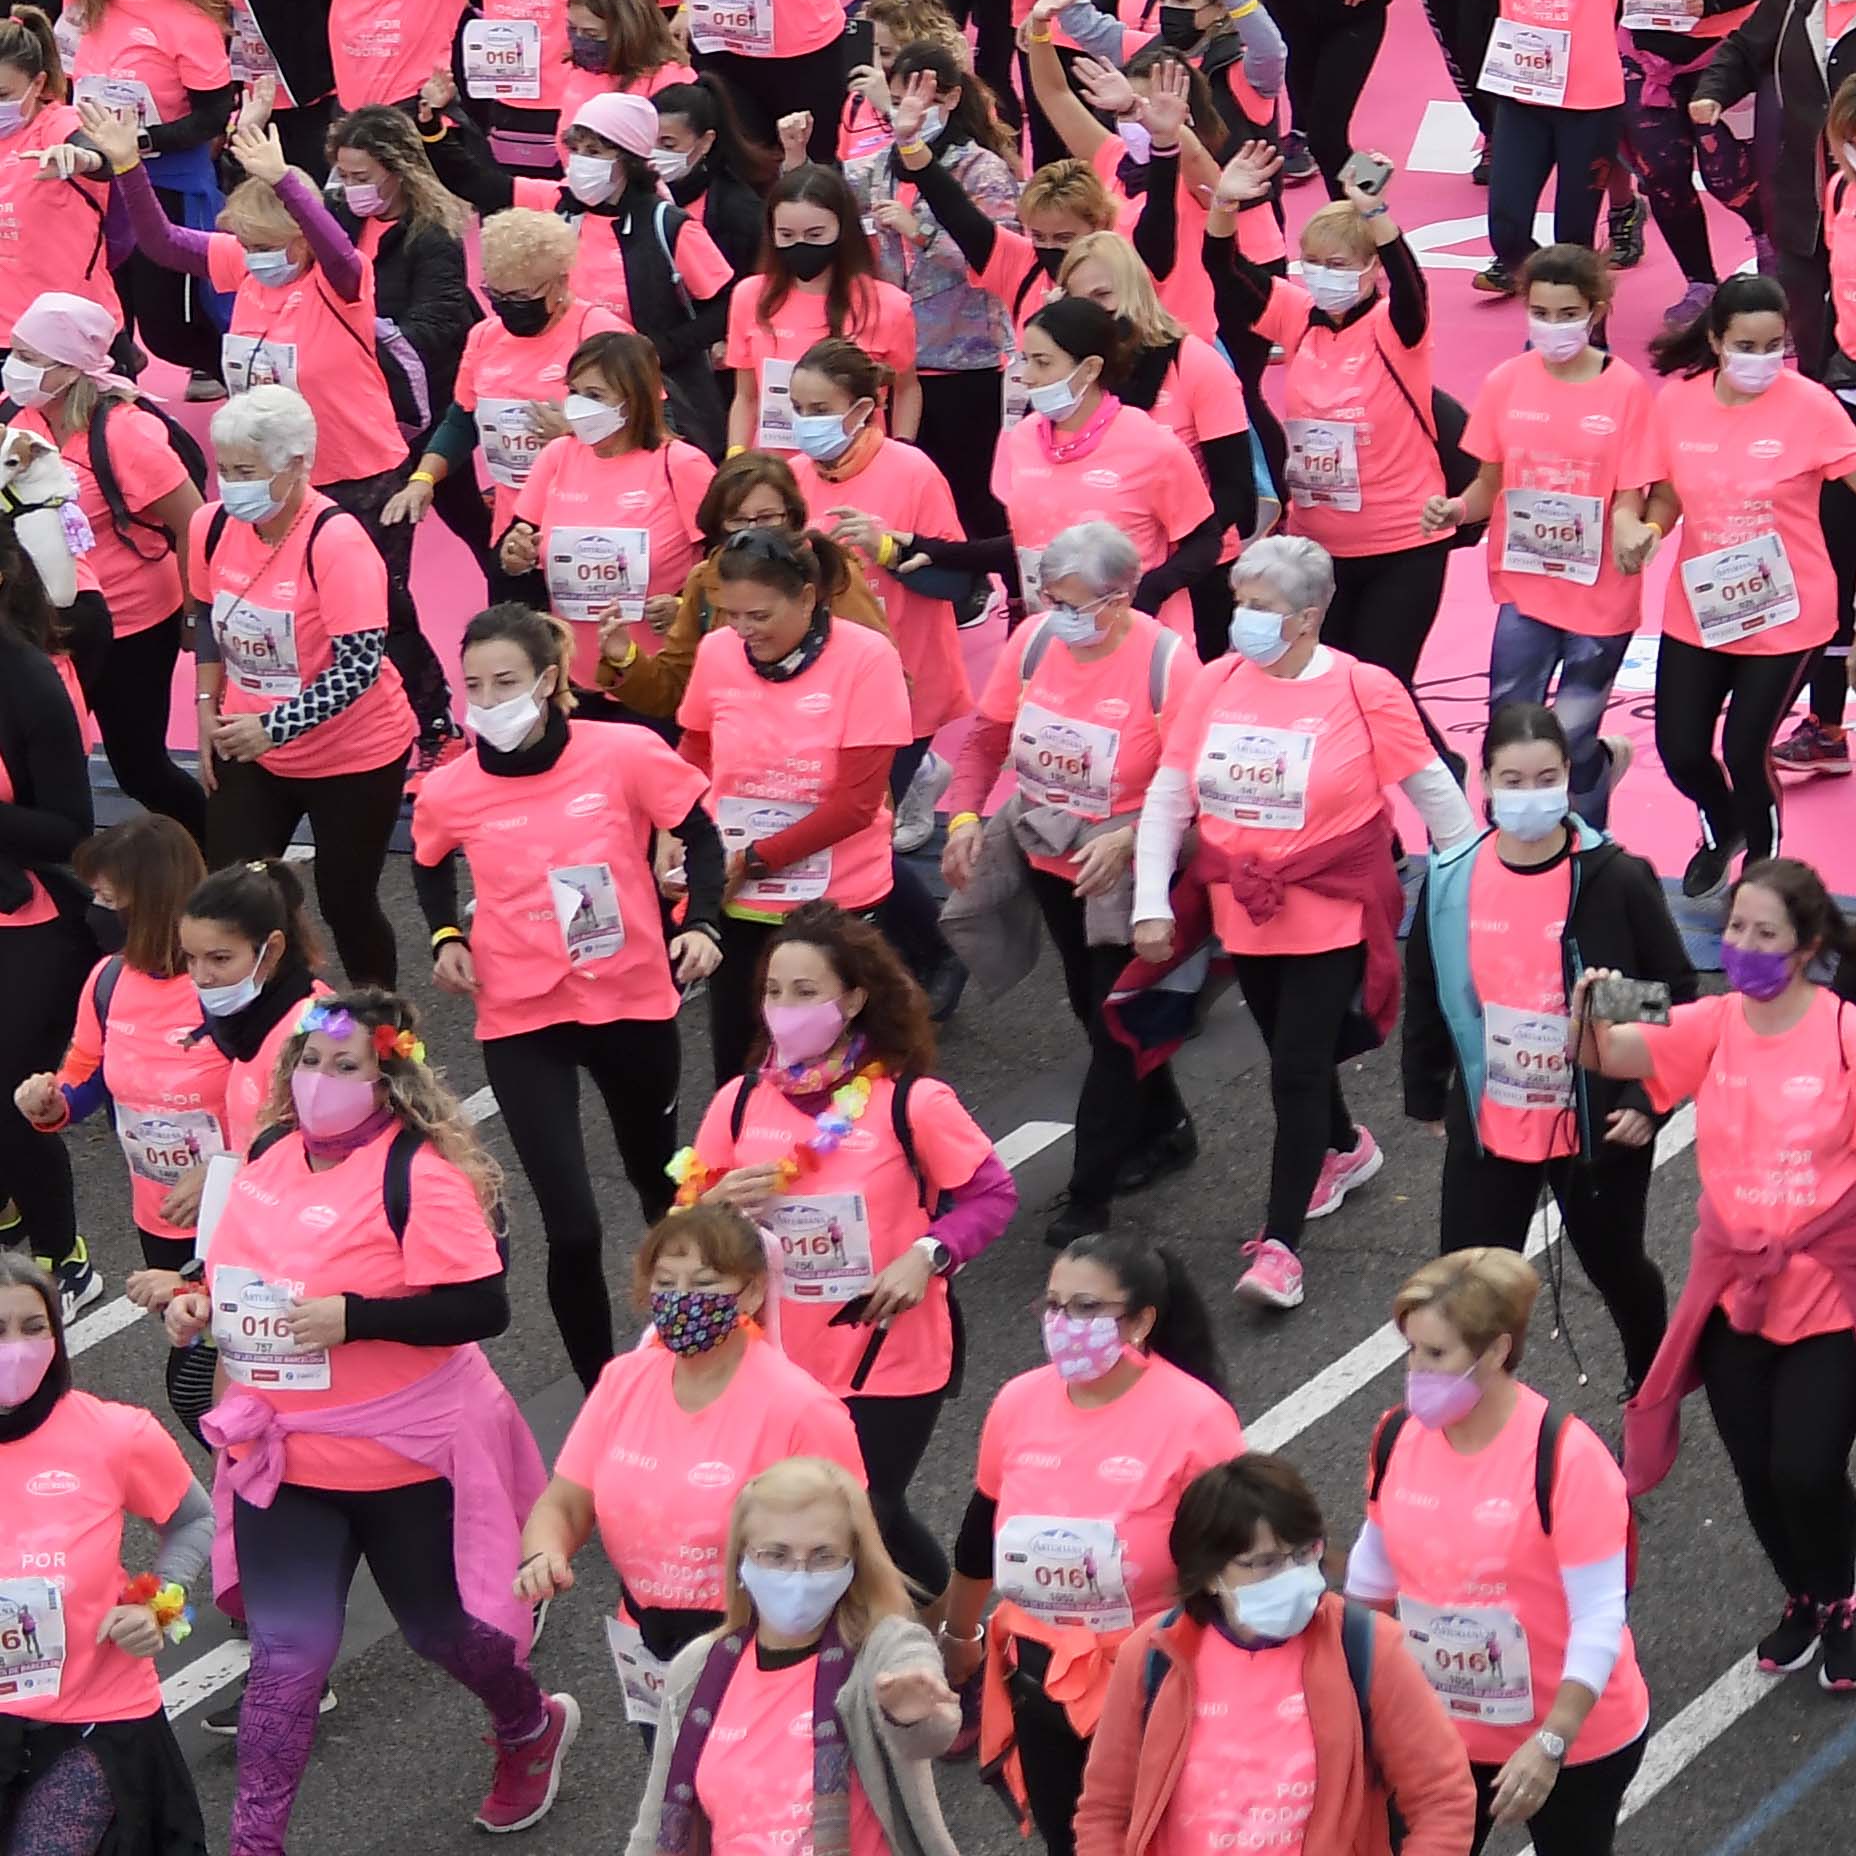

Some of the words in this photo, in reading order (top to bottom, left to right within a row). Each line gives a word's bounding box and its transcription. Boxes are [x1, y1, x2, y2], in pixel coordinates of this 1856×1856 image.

[714, 13, 747, 26] 016
[487, 51, 516, 64] 016
[1516, 53, 1545, 69] 016
[503, 435, 537, 450] 016
[1304, 456, 1332, 471] 016
[1536, 524, 1574, 541] 016
[578, 564, 617, 579] 016
[1722, 577, 1763, 600] 016
[1039, 751, 1080, 774] 016
[1229, 764, 1272, 783] 016
[1517, 1051, 1562, 1071] 016
[147, 1147, 189, 1166] 016
[780, 1236, 831, 1255] 016
[243, 1316, 290, 1337] 016
[680, 1546, 718, 1561] POR
[1036, 1566, 1084, 1588] 016
[1436, 1648, 1487, 1672] 016
